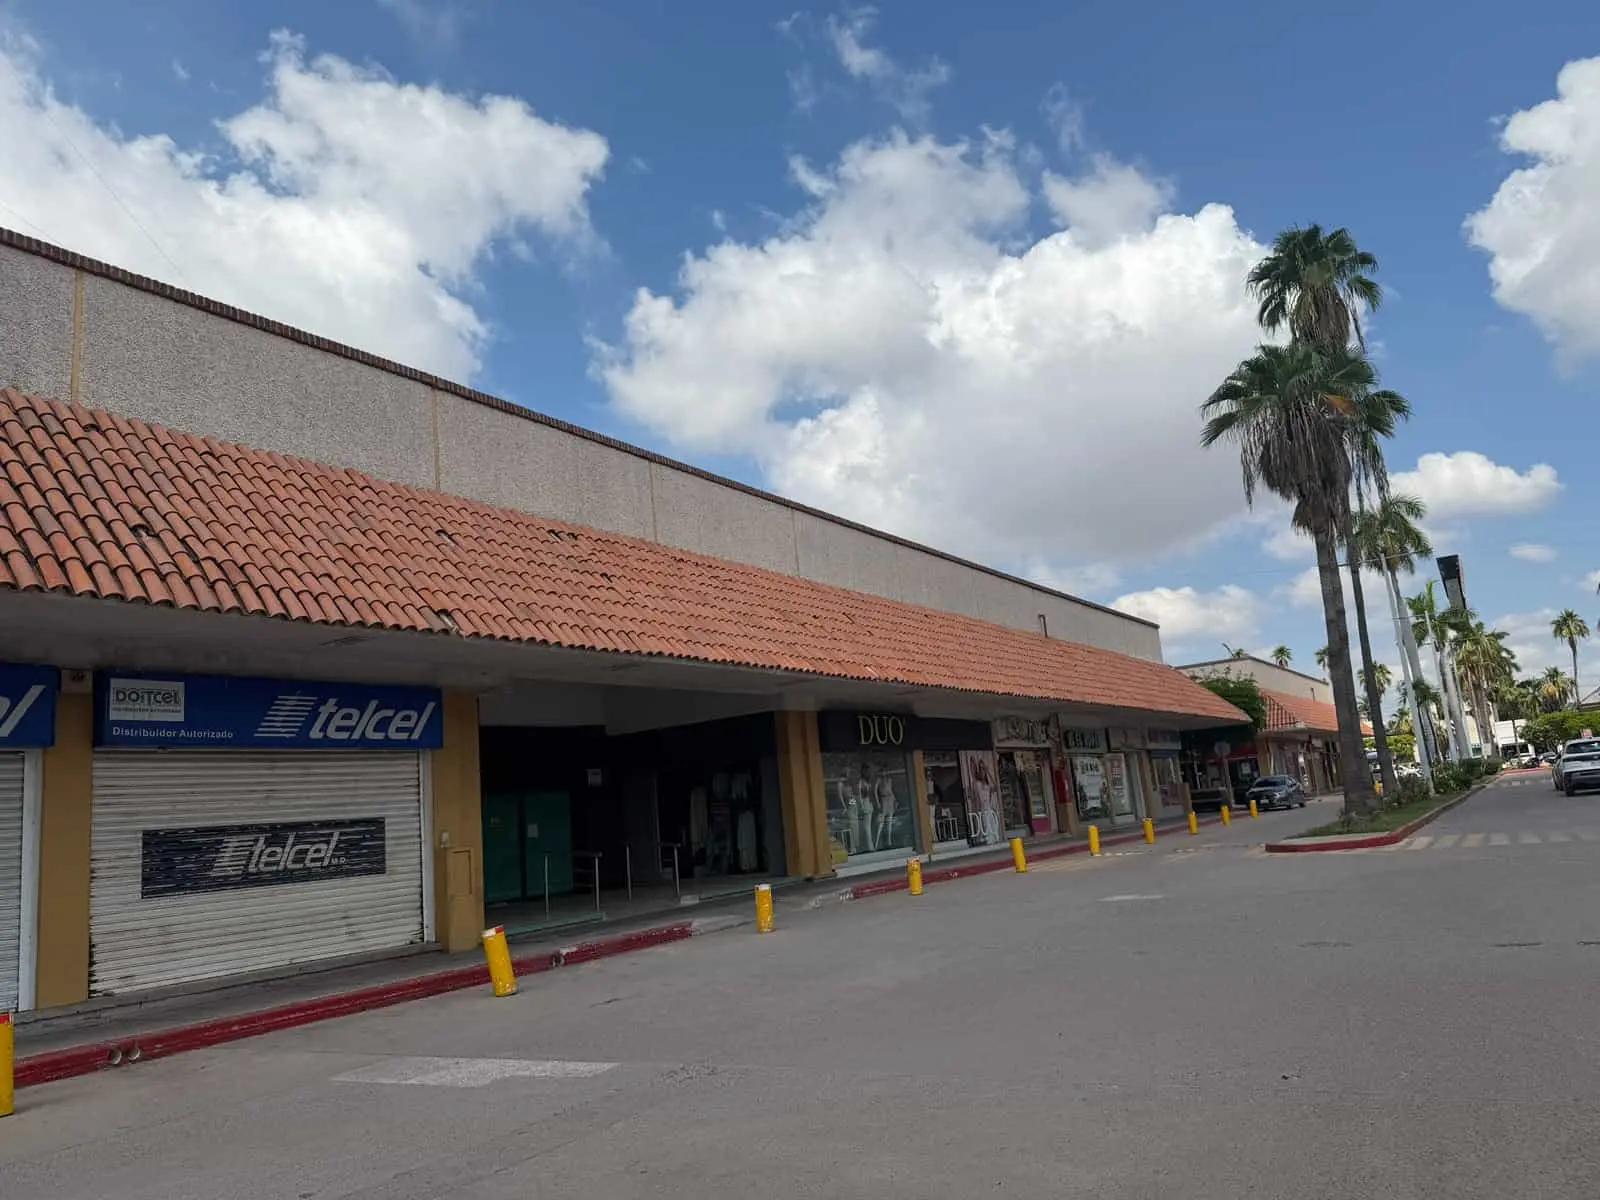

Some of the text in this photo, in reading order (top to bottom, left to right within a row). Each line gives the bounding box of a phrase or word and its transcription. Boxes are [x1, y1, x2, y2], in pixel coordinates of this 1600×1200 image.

[112, 727, 234, 740] Distribuidor Autorizado
[309, 698, 436, 740] telcel
[856, 715, 904, 745] DUO
[248, 832, 339, 873] telcel
